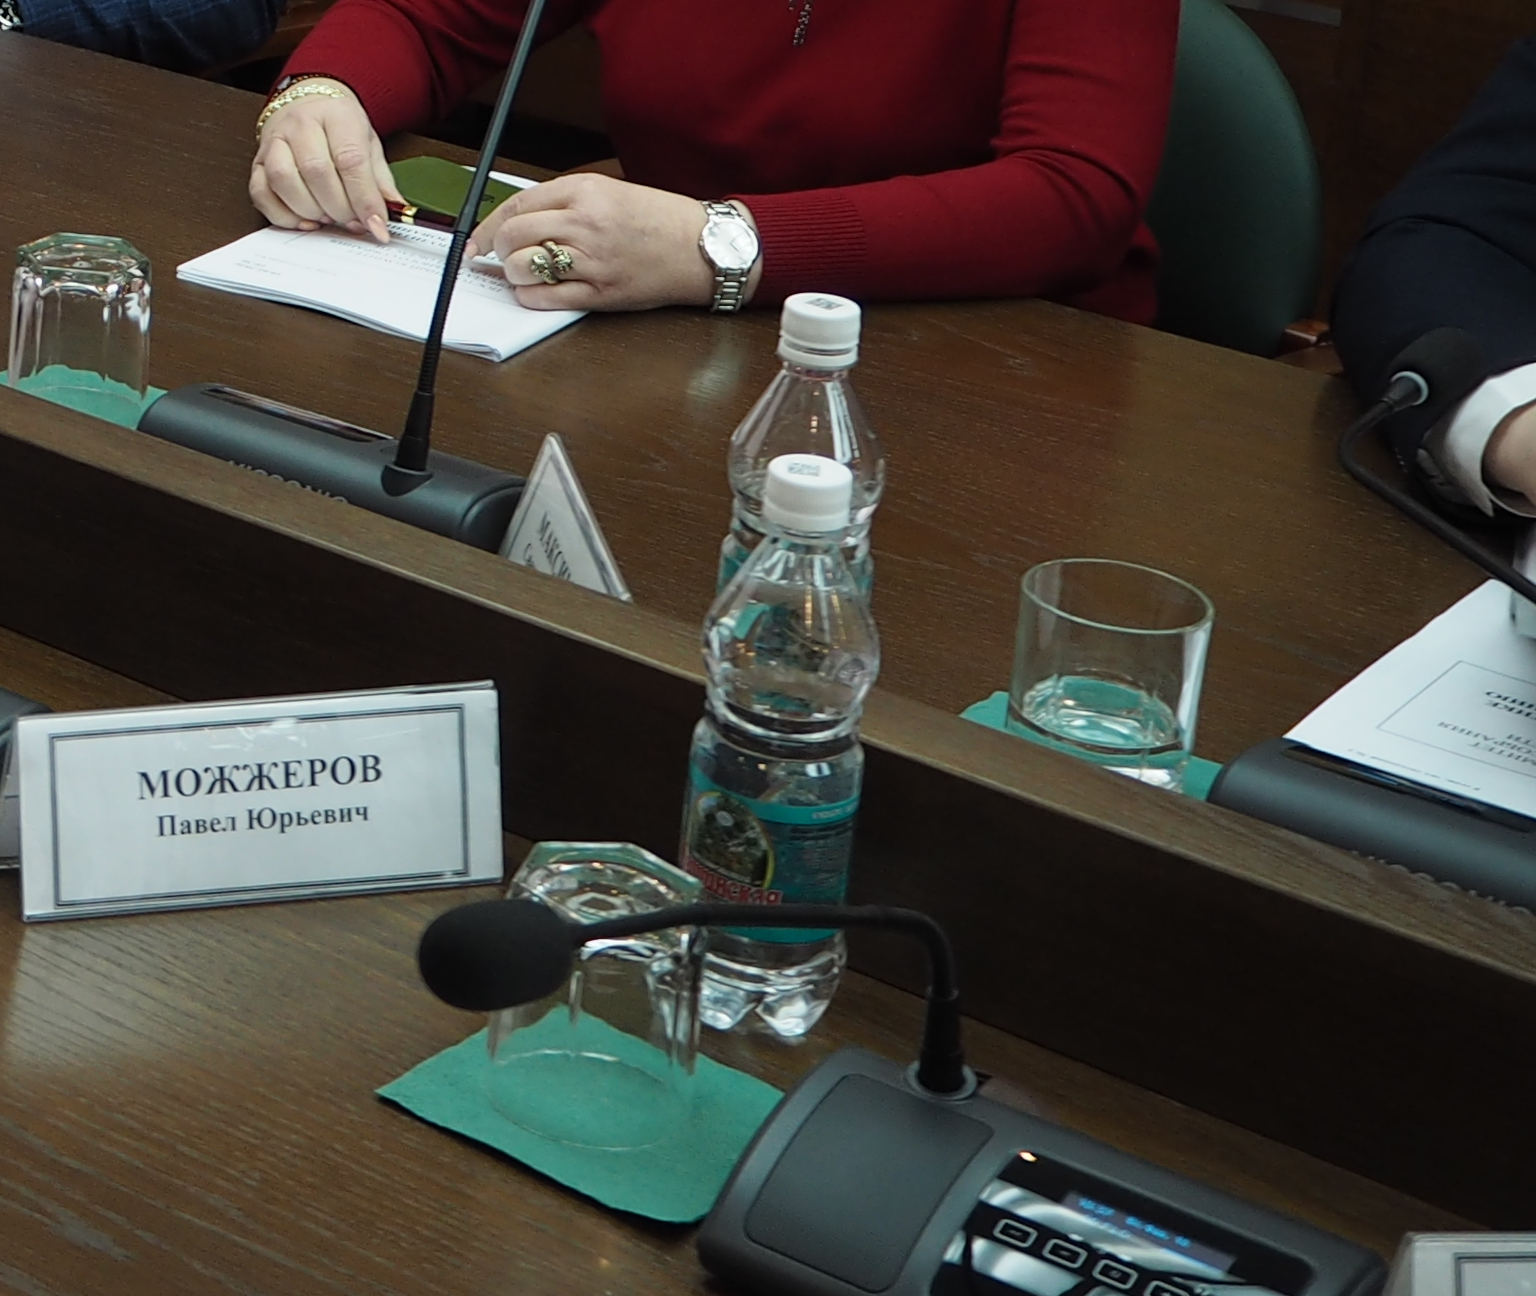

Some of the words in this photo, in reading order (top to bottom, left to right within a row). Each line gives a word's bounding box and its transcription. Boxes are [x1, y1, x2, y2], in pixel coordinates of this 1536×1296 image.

[137, 754, 384, 800] МОЖЖЕРОВ
[157, 814, 237, 837] Павел
[246, 806, 369, 834] Юрьевич
